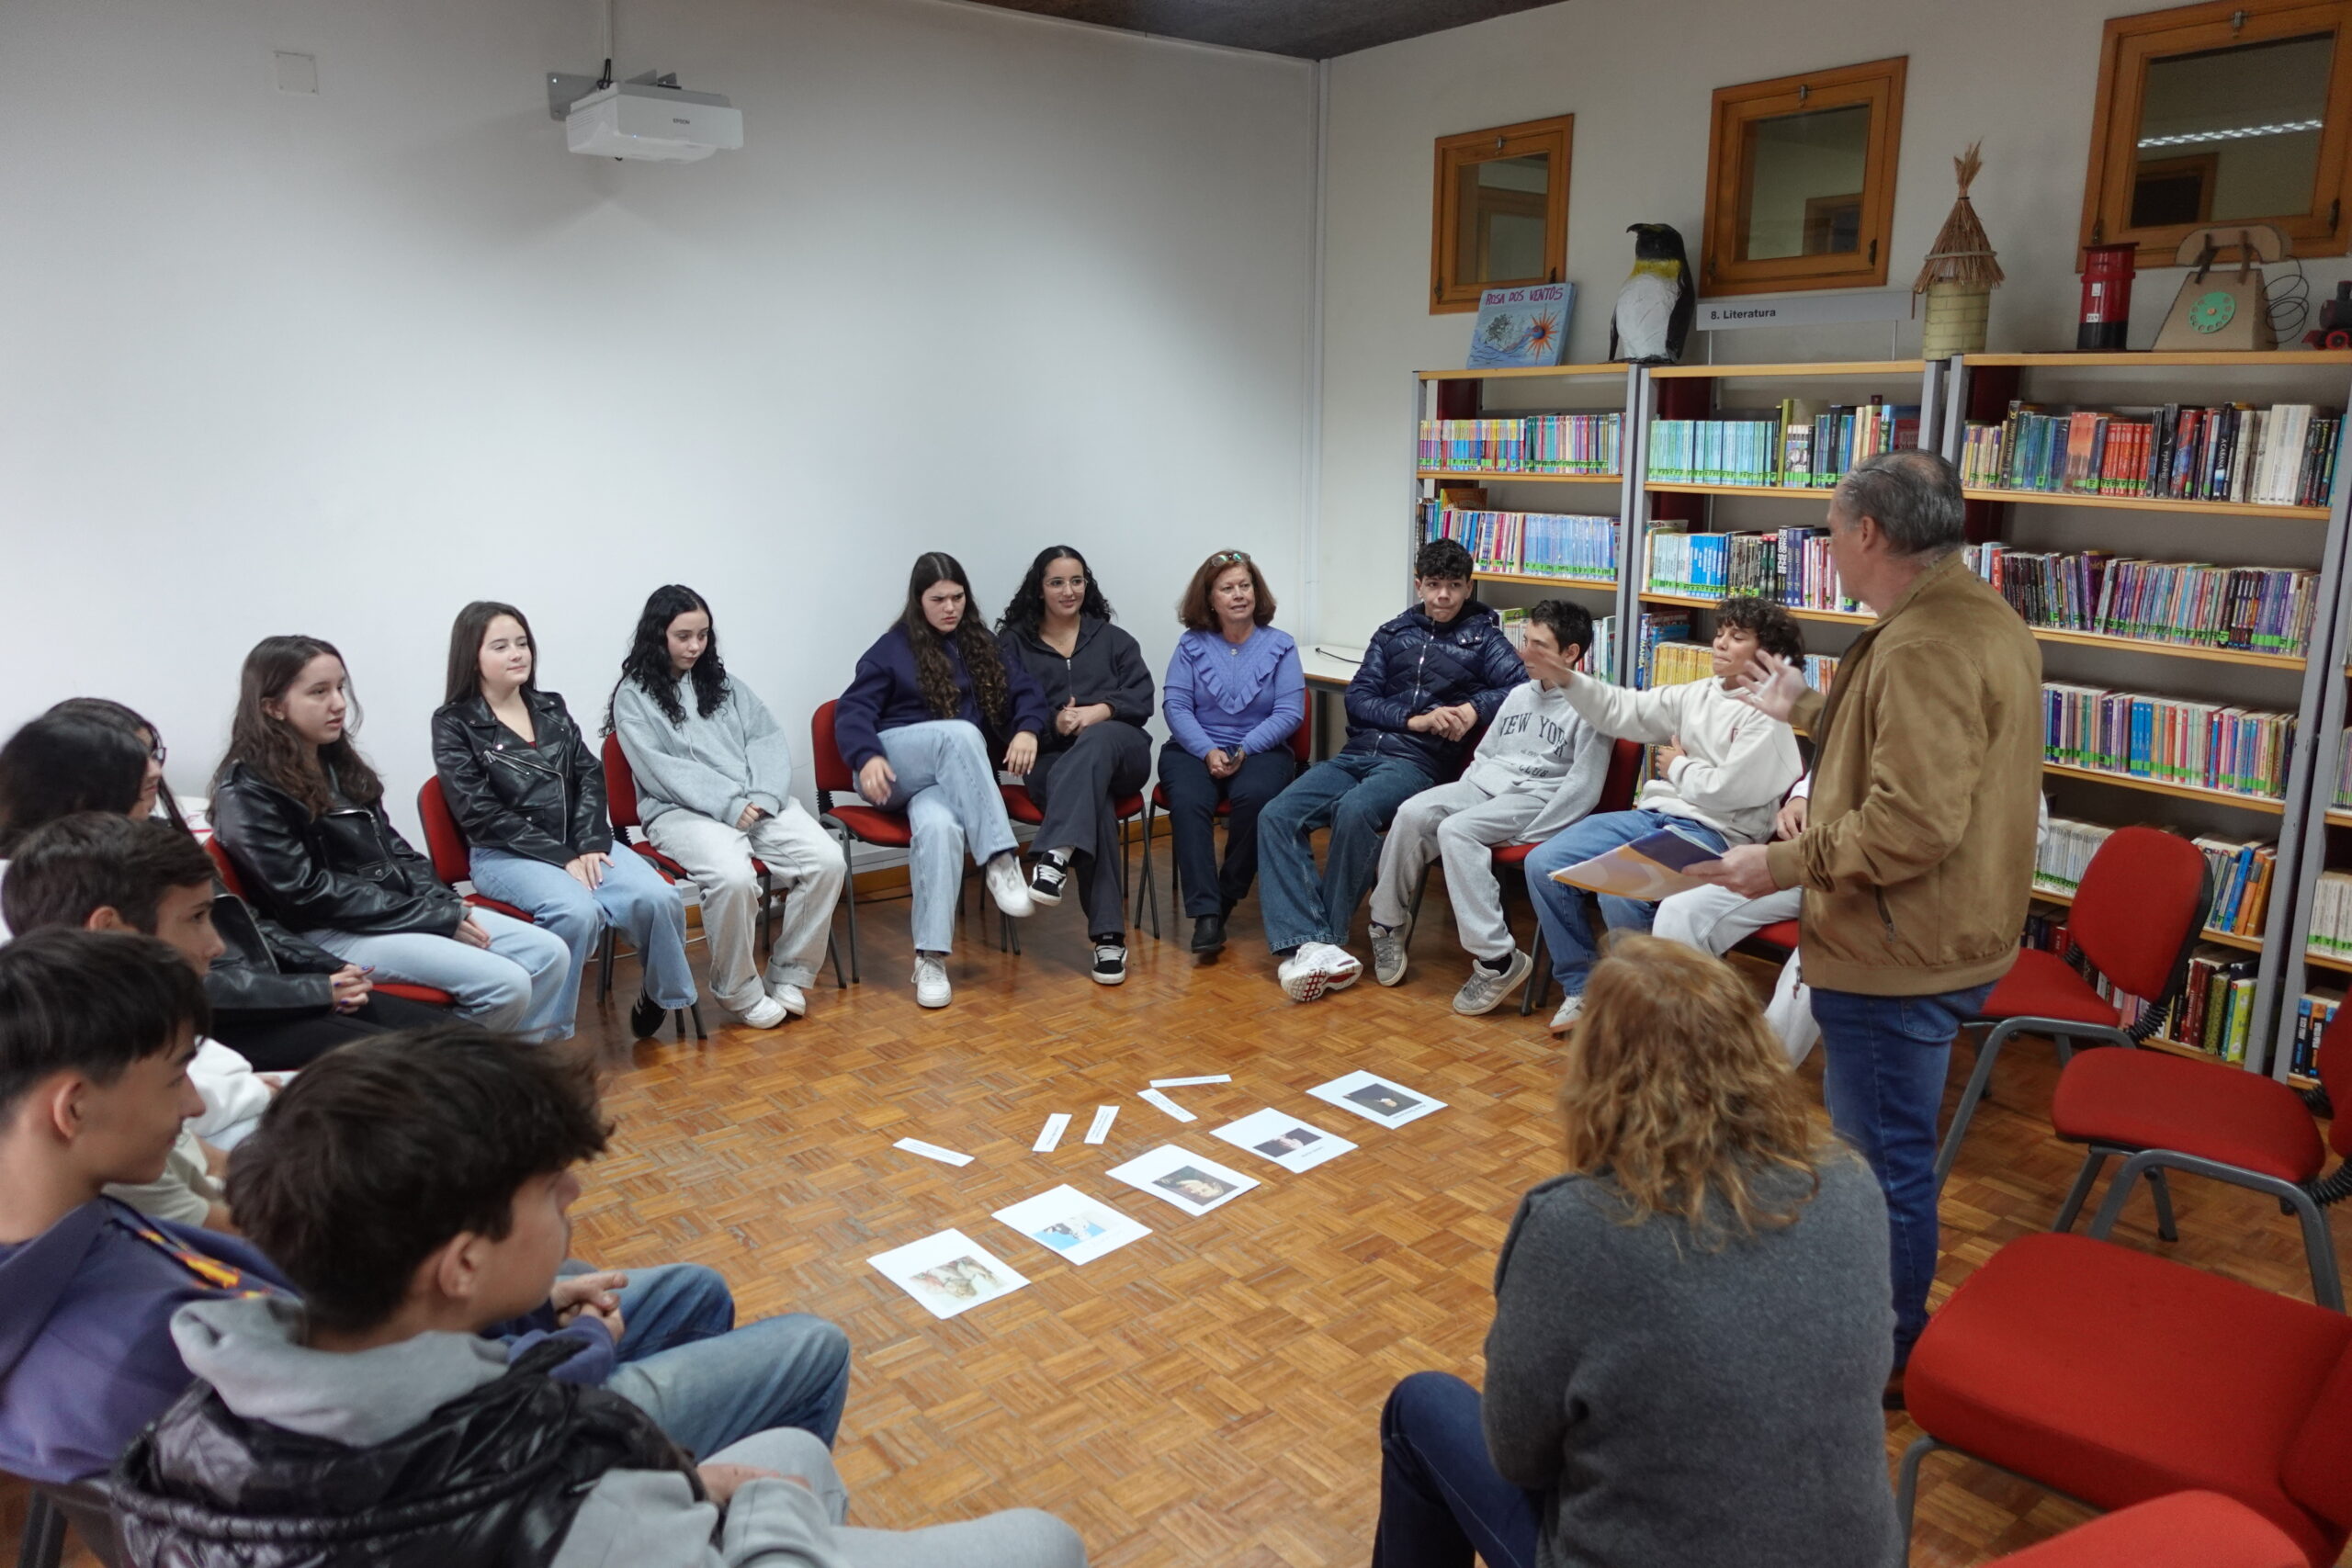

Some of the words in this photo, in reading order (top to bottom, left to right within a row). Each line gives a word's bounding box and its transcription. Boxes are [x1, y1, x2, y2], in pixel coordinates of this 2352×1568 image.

[1486, 293, 1506, 306] ROSA
[1509, 289, 1525, 302] DOS
[1529, 286, 1564, 302] VENTOS
[1711, 310, 1720, 320] 8.
[1723, 309, 1776, 320] Literatura
